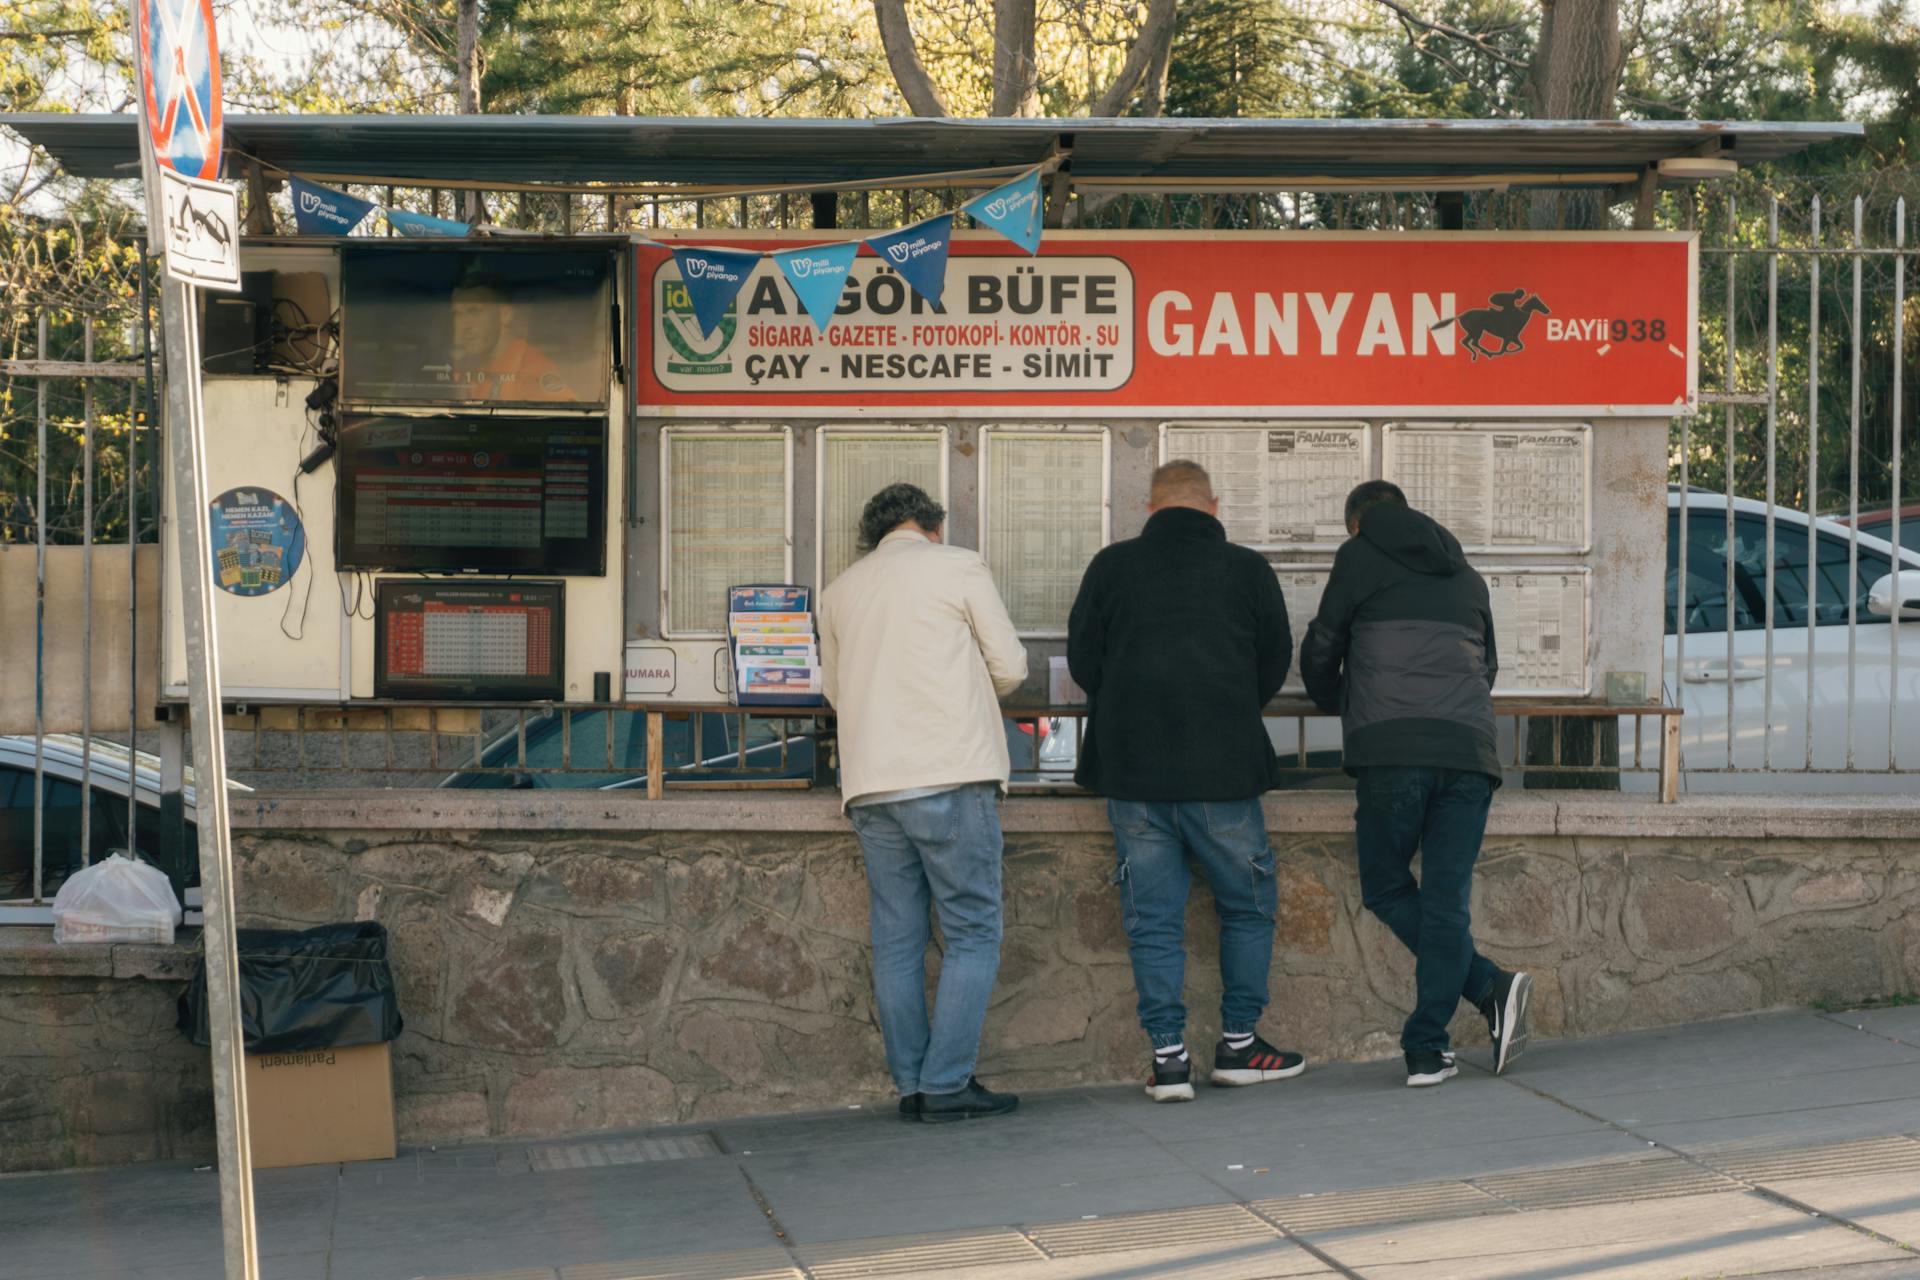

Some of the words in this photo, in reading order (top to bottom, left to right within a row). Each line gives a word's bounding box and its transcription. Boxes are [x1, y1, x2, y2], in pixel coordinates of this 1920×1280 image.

[320, 203, 337, 213] milli
[317, 210, 349, 224] piyango
[909, 238, 926, 250] milli
[911, 240, 942, 257] piyango
[707, 264, 725, 273] milli
[810, 259, 829, 268] milli
[813, 265, 845, 276] piyango
[706, 271, 739, 282] piyango
[968, 266, 1117, 315] BÜFE
[1147, 290, 1456, 356] GANYAN
[1611, 319, 1666, 342] 938
[748, 320, 813, 347] SİGARA
[829, 325, 897, 347] GAZETE
[1009, 320, 1081, 346] KONTÖR
[1096, 324, 1119, 346] SU
[745, 354, 810, 386] ÇAY
[841, 353, 991, 379] NESCAFE
[1022, 347, 1113, 378] SİMİT
[260, 1052, 336, 1069] Parliament
